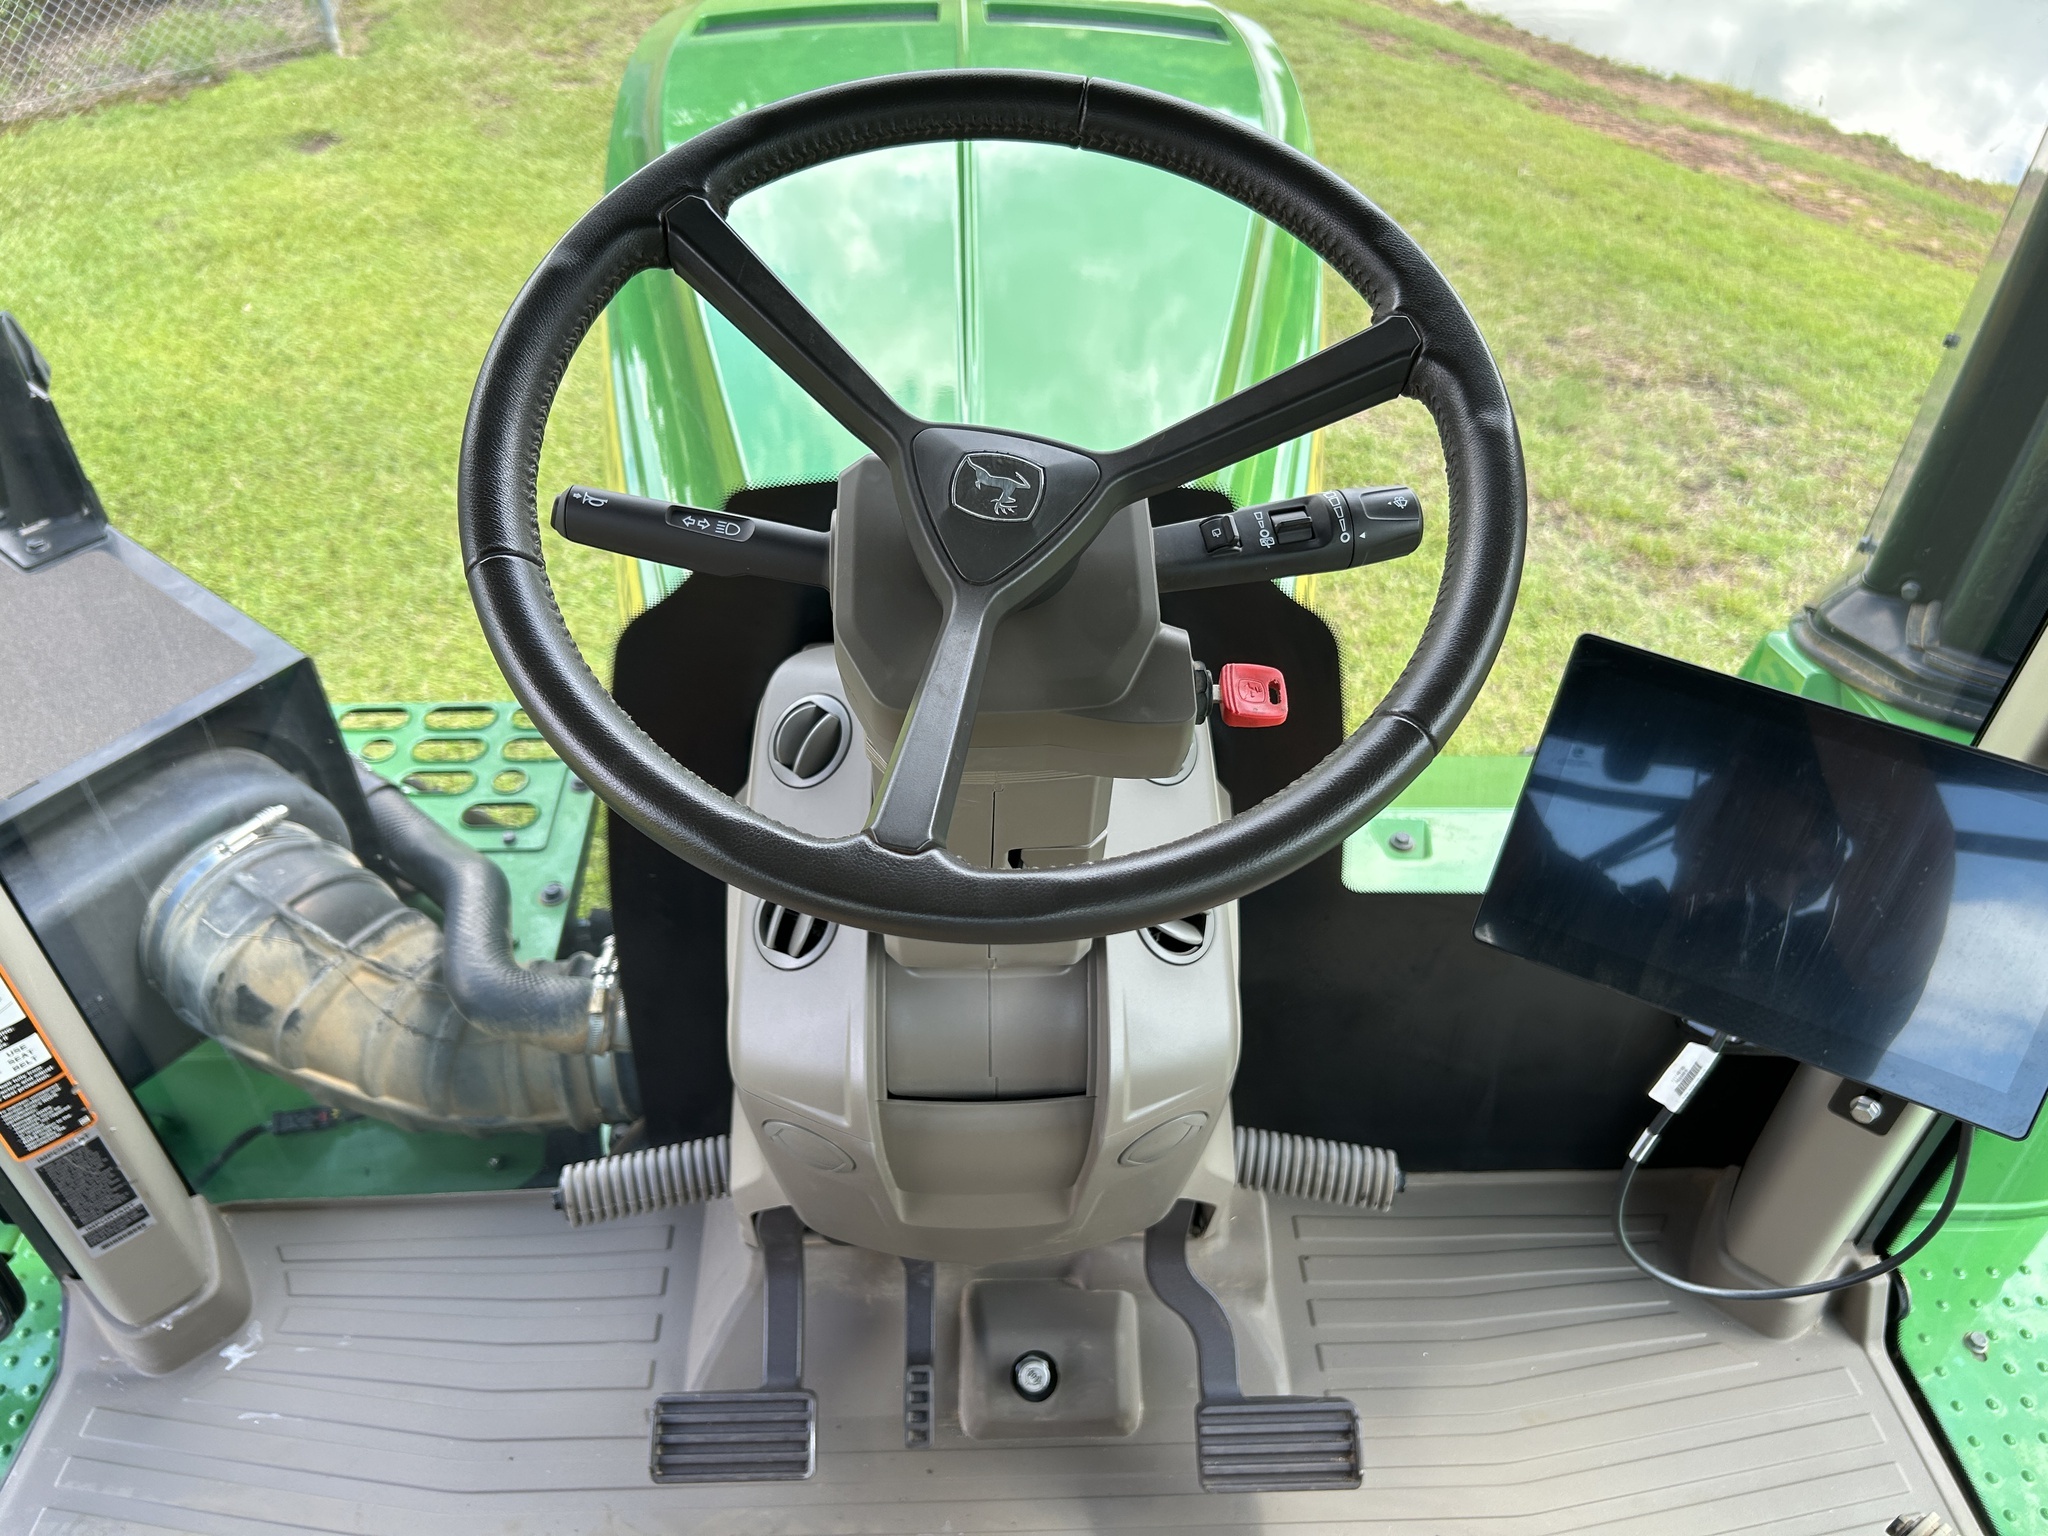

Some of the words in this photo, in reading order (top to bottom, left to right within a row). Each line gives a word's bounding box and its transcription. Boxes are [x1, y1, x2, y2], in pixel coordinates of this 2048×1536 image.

[6, 1044, 27, 1057] USE
[7, 1048, 34, 1065] SEAT
[12, 1055, 37, 1072] BELT
[36, 1132, 90, 1163] IMPORTANT
